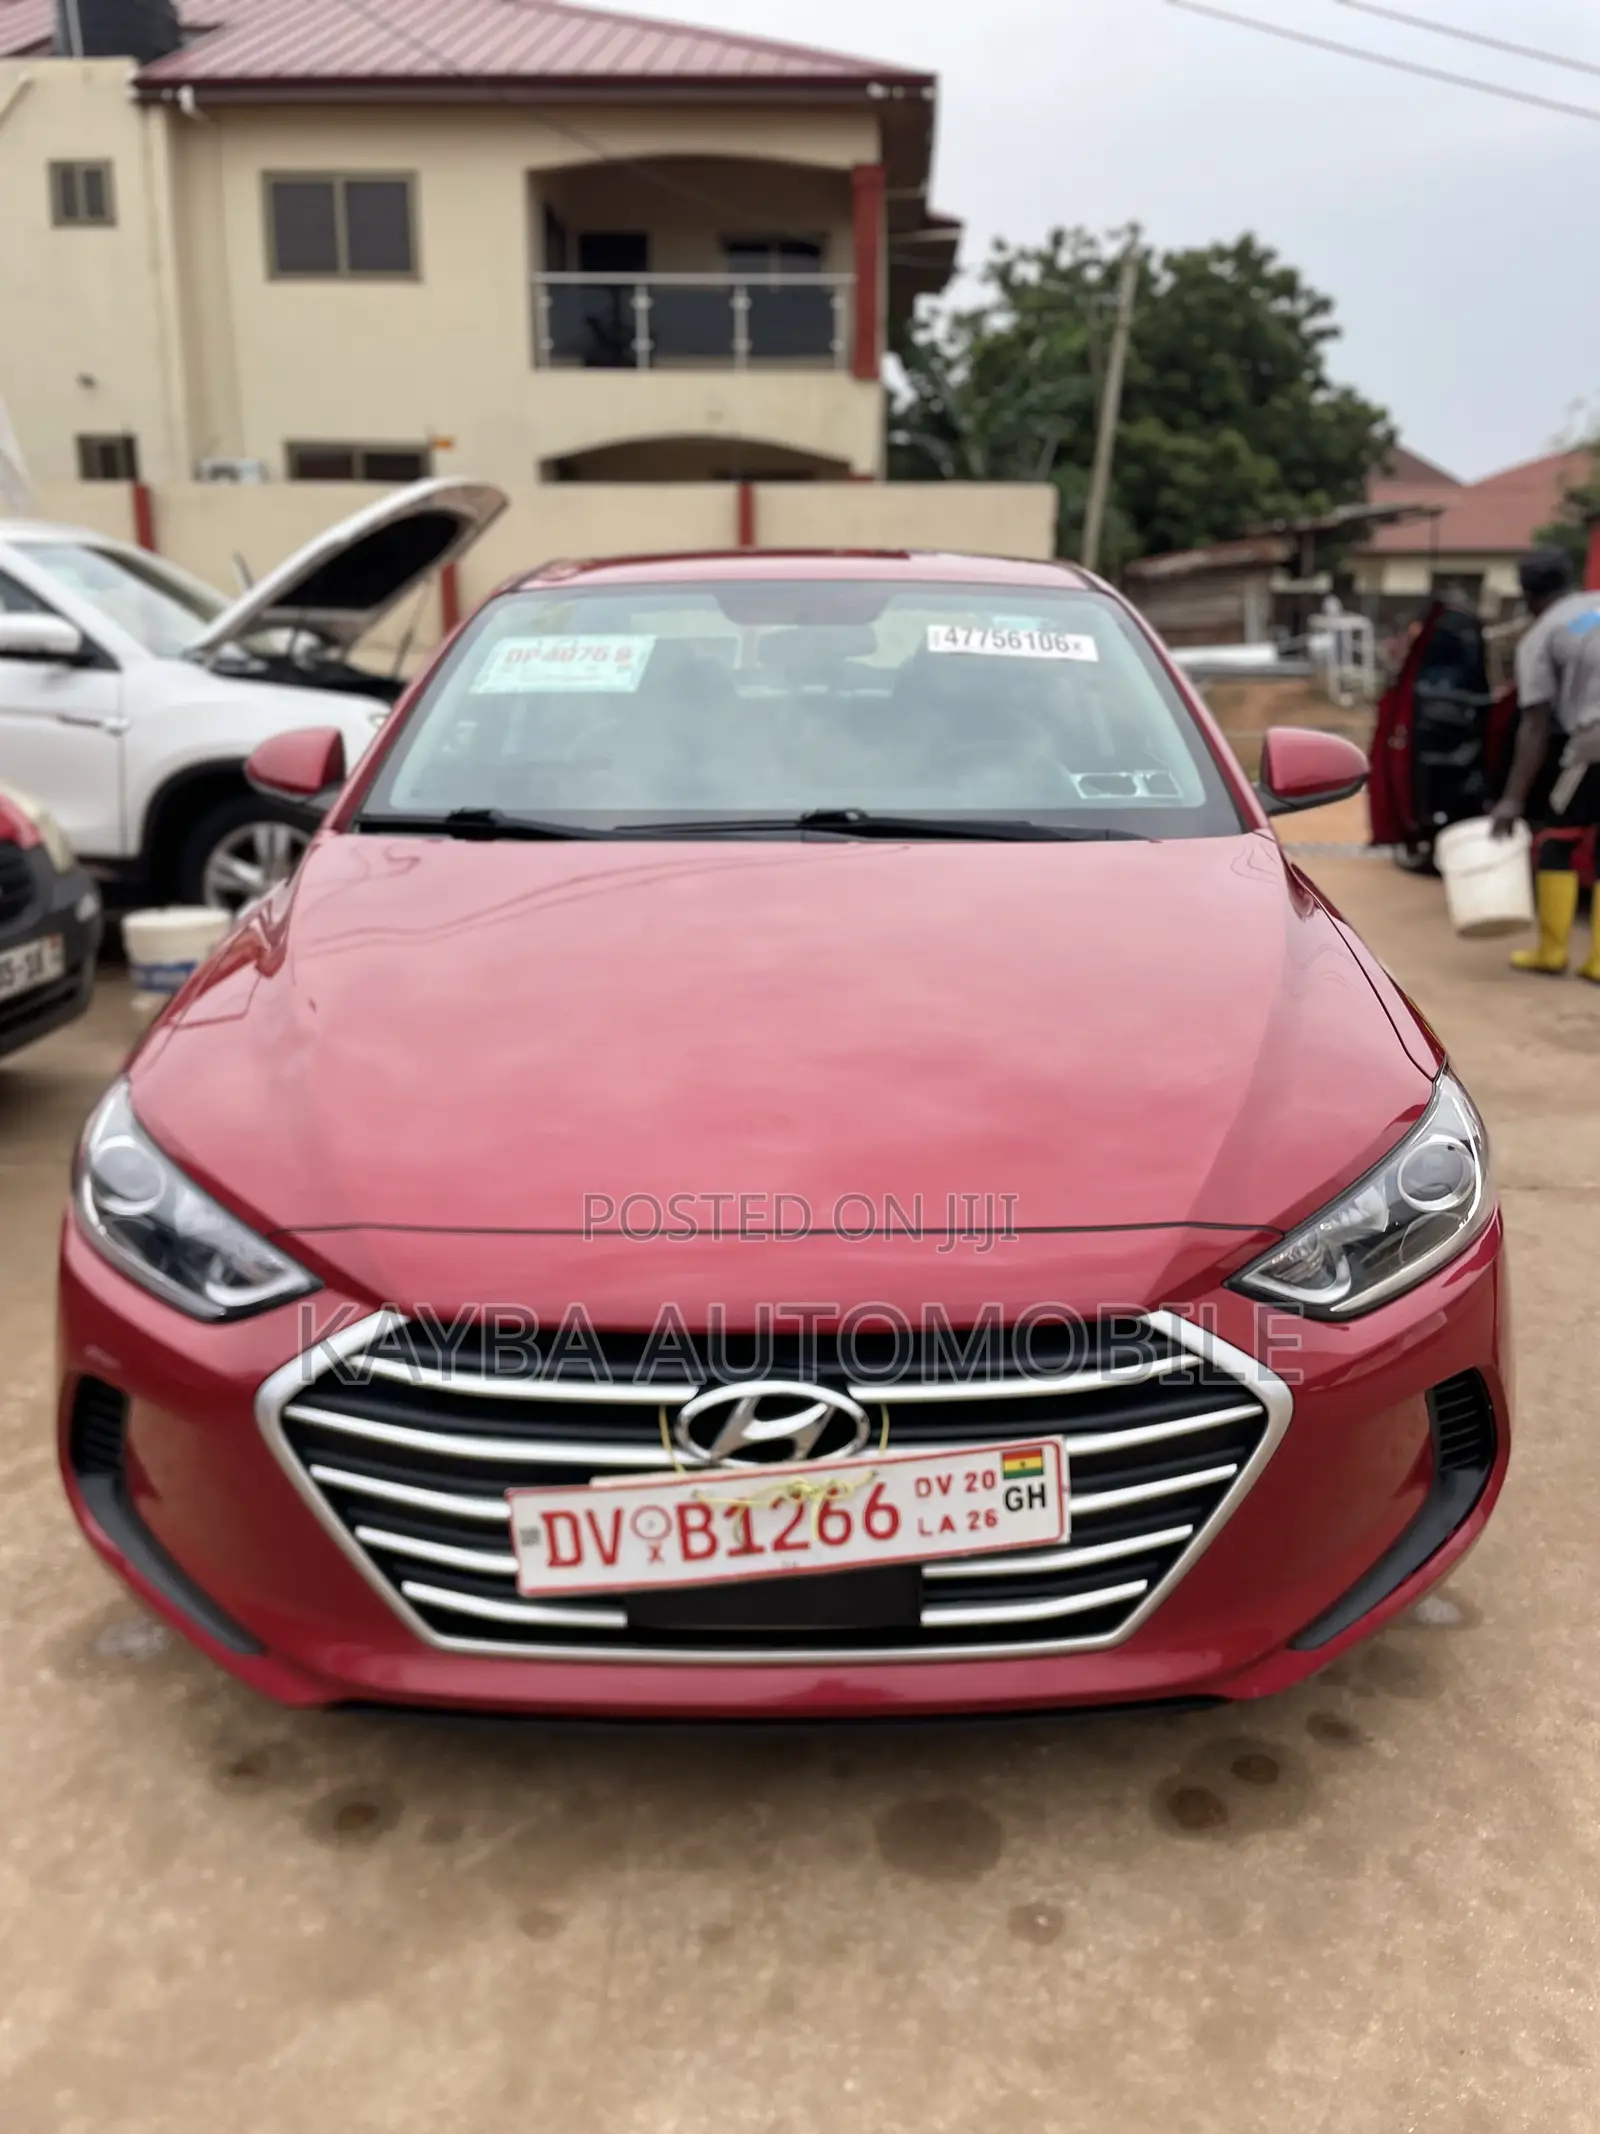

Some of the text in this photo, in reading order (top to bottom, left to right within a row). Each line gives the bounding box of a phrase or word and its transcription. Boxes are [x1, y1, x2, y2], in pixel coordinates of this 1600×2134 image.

[914, 1469, 997, 1498] DV 20
[1004, 1482, 1047, 1512] GH
[541, 1481, 902, 1569] DV B1266
[917, 1508, 999, 1537] LA 26
